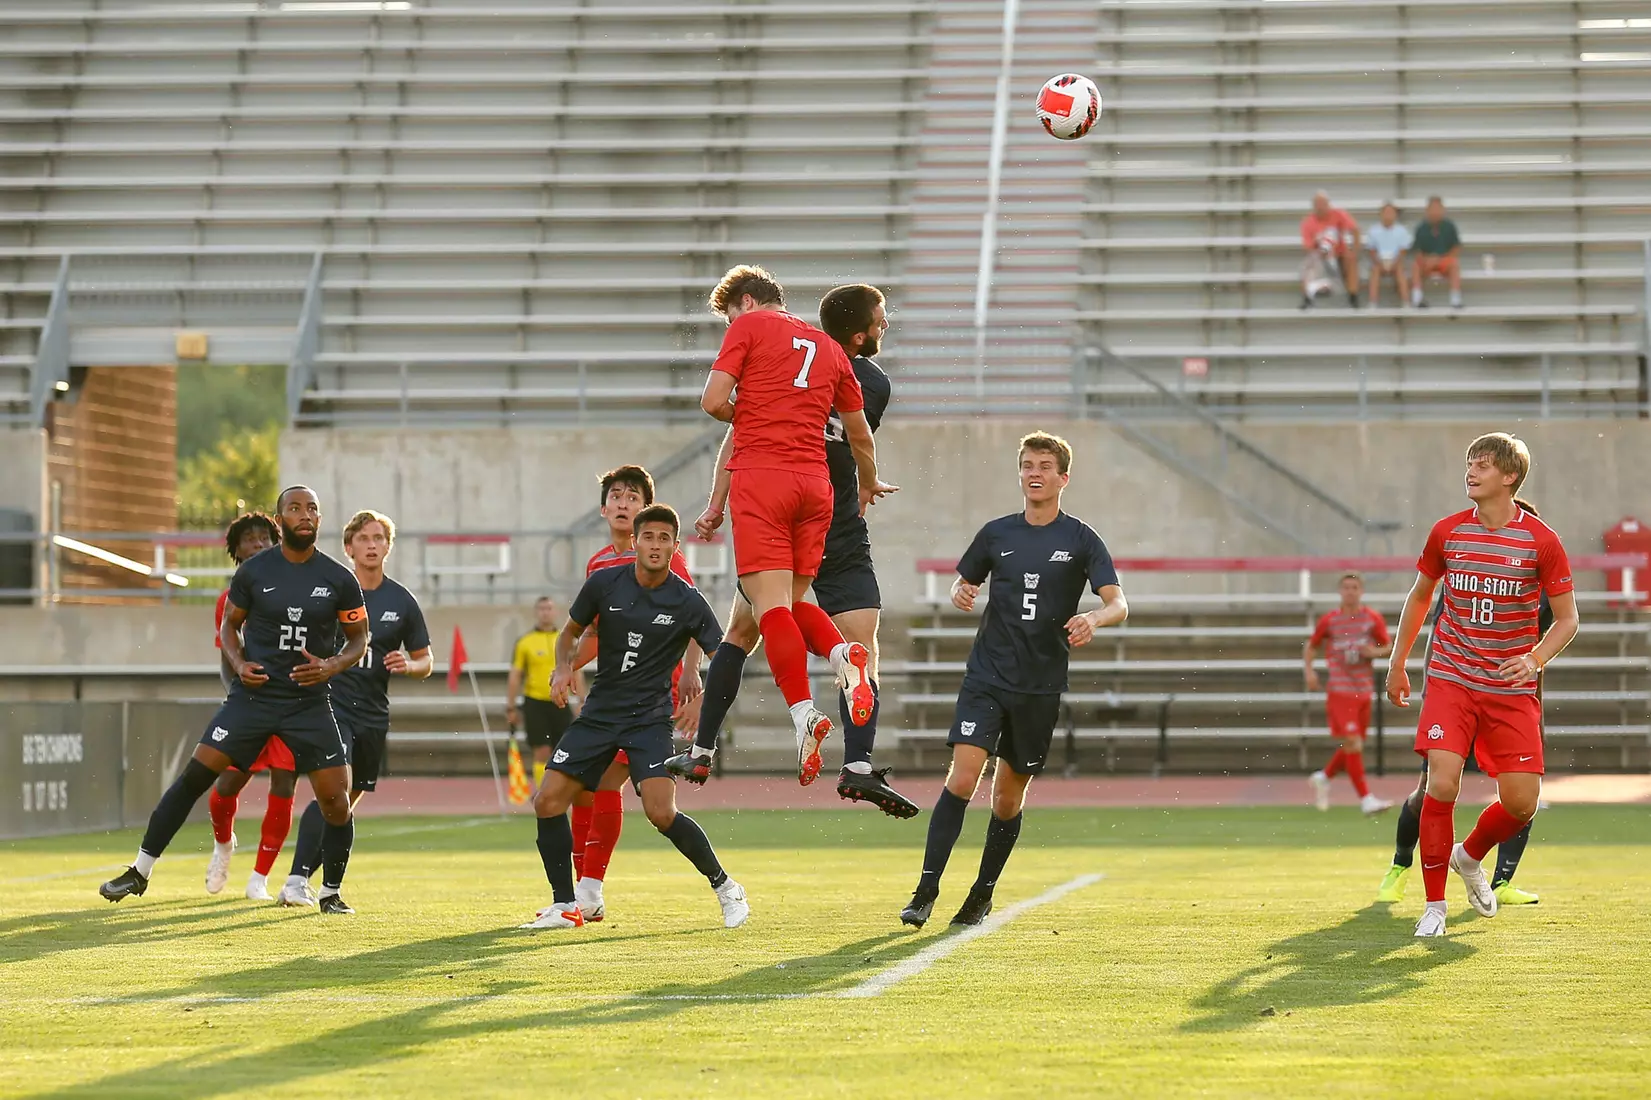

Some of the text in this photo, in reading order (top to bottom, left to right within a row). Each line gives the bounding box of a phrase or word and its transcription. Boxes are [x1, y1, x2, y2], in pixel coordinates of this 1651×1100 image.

[792, 336, 817, 388] 7
[1449, 573, 1522, 597] OHIO STATE
[347, 611, 358, 621] C
[1021, 593, 1038, 621] 5
[1470, 596, 1494, 625] 18
[279, 624, 308, 651] 25
